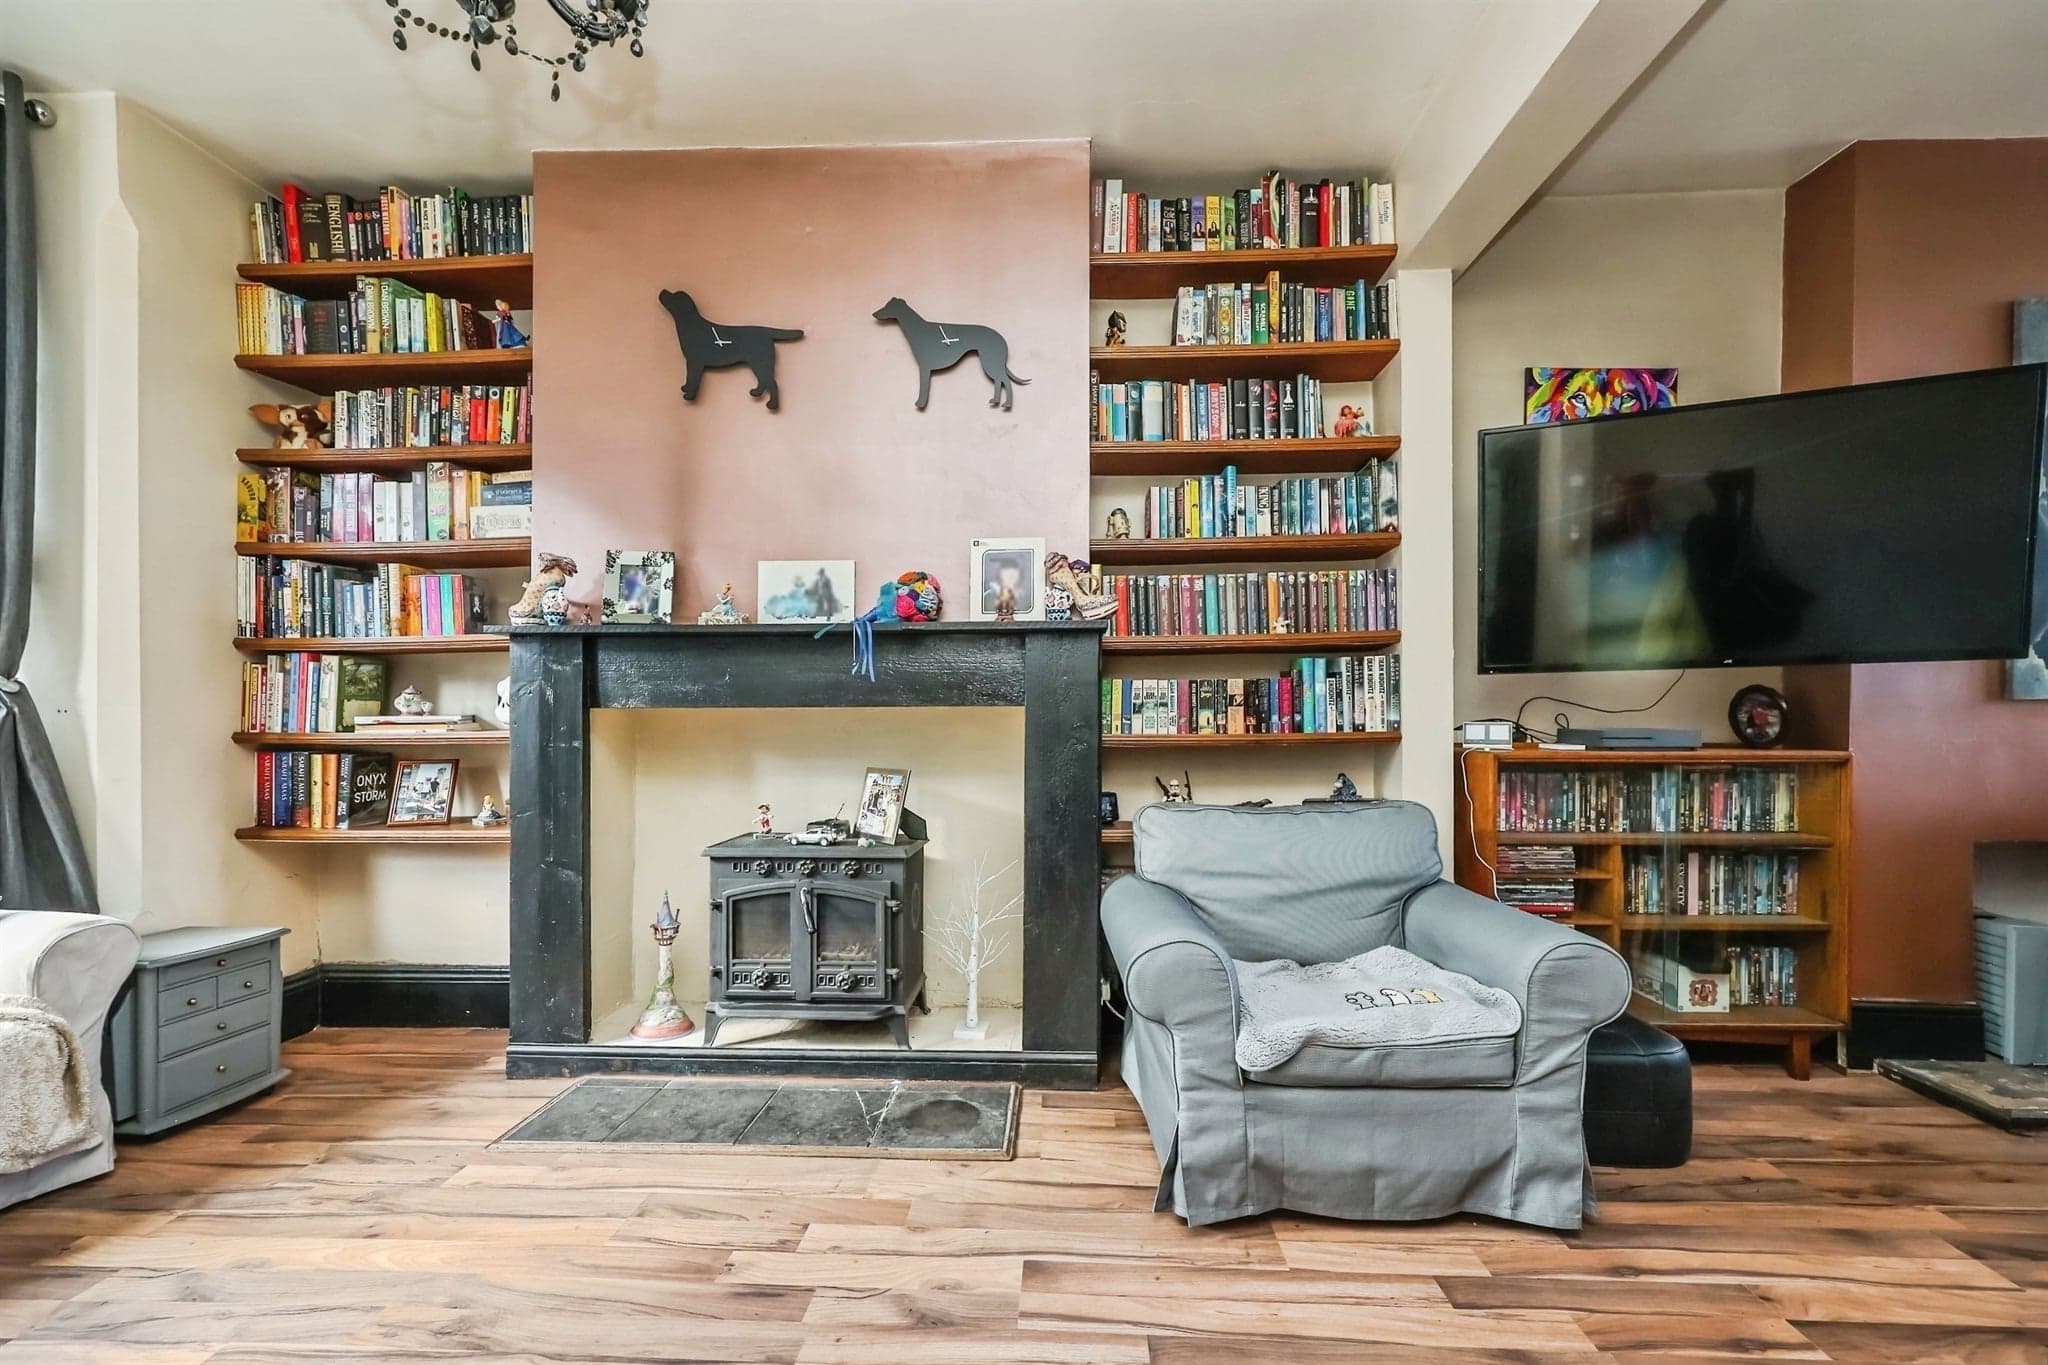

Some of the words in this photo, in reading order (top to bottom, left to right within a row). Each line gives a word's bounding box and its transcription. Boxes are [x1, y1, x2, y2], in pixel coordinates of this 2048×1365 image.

[327, 203, 345, 249] ENGLISH
[366, 284, 374, 301] DAN
[381, 284, 389, 301] DAN
[366, 301, 375, 328] BROWN
[382, 301, 390, 328] BROWN
[1211, 391, 1220, 426] BRYSON
[1258, 488, 1269, 508] KING
[263, 755, 271, 776] SARAH
[356, 772, 387, 787] ONYX
[354, 789, 386, 803] STORM
[1677, 885, 1685, 906] CITY
